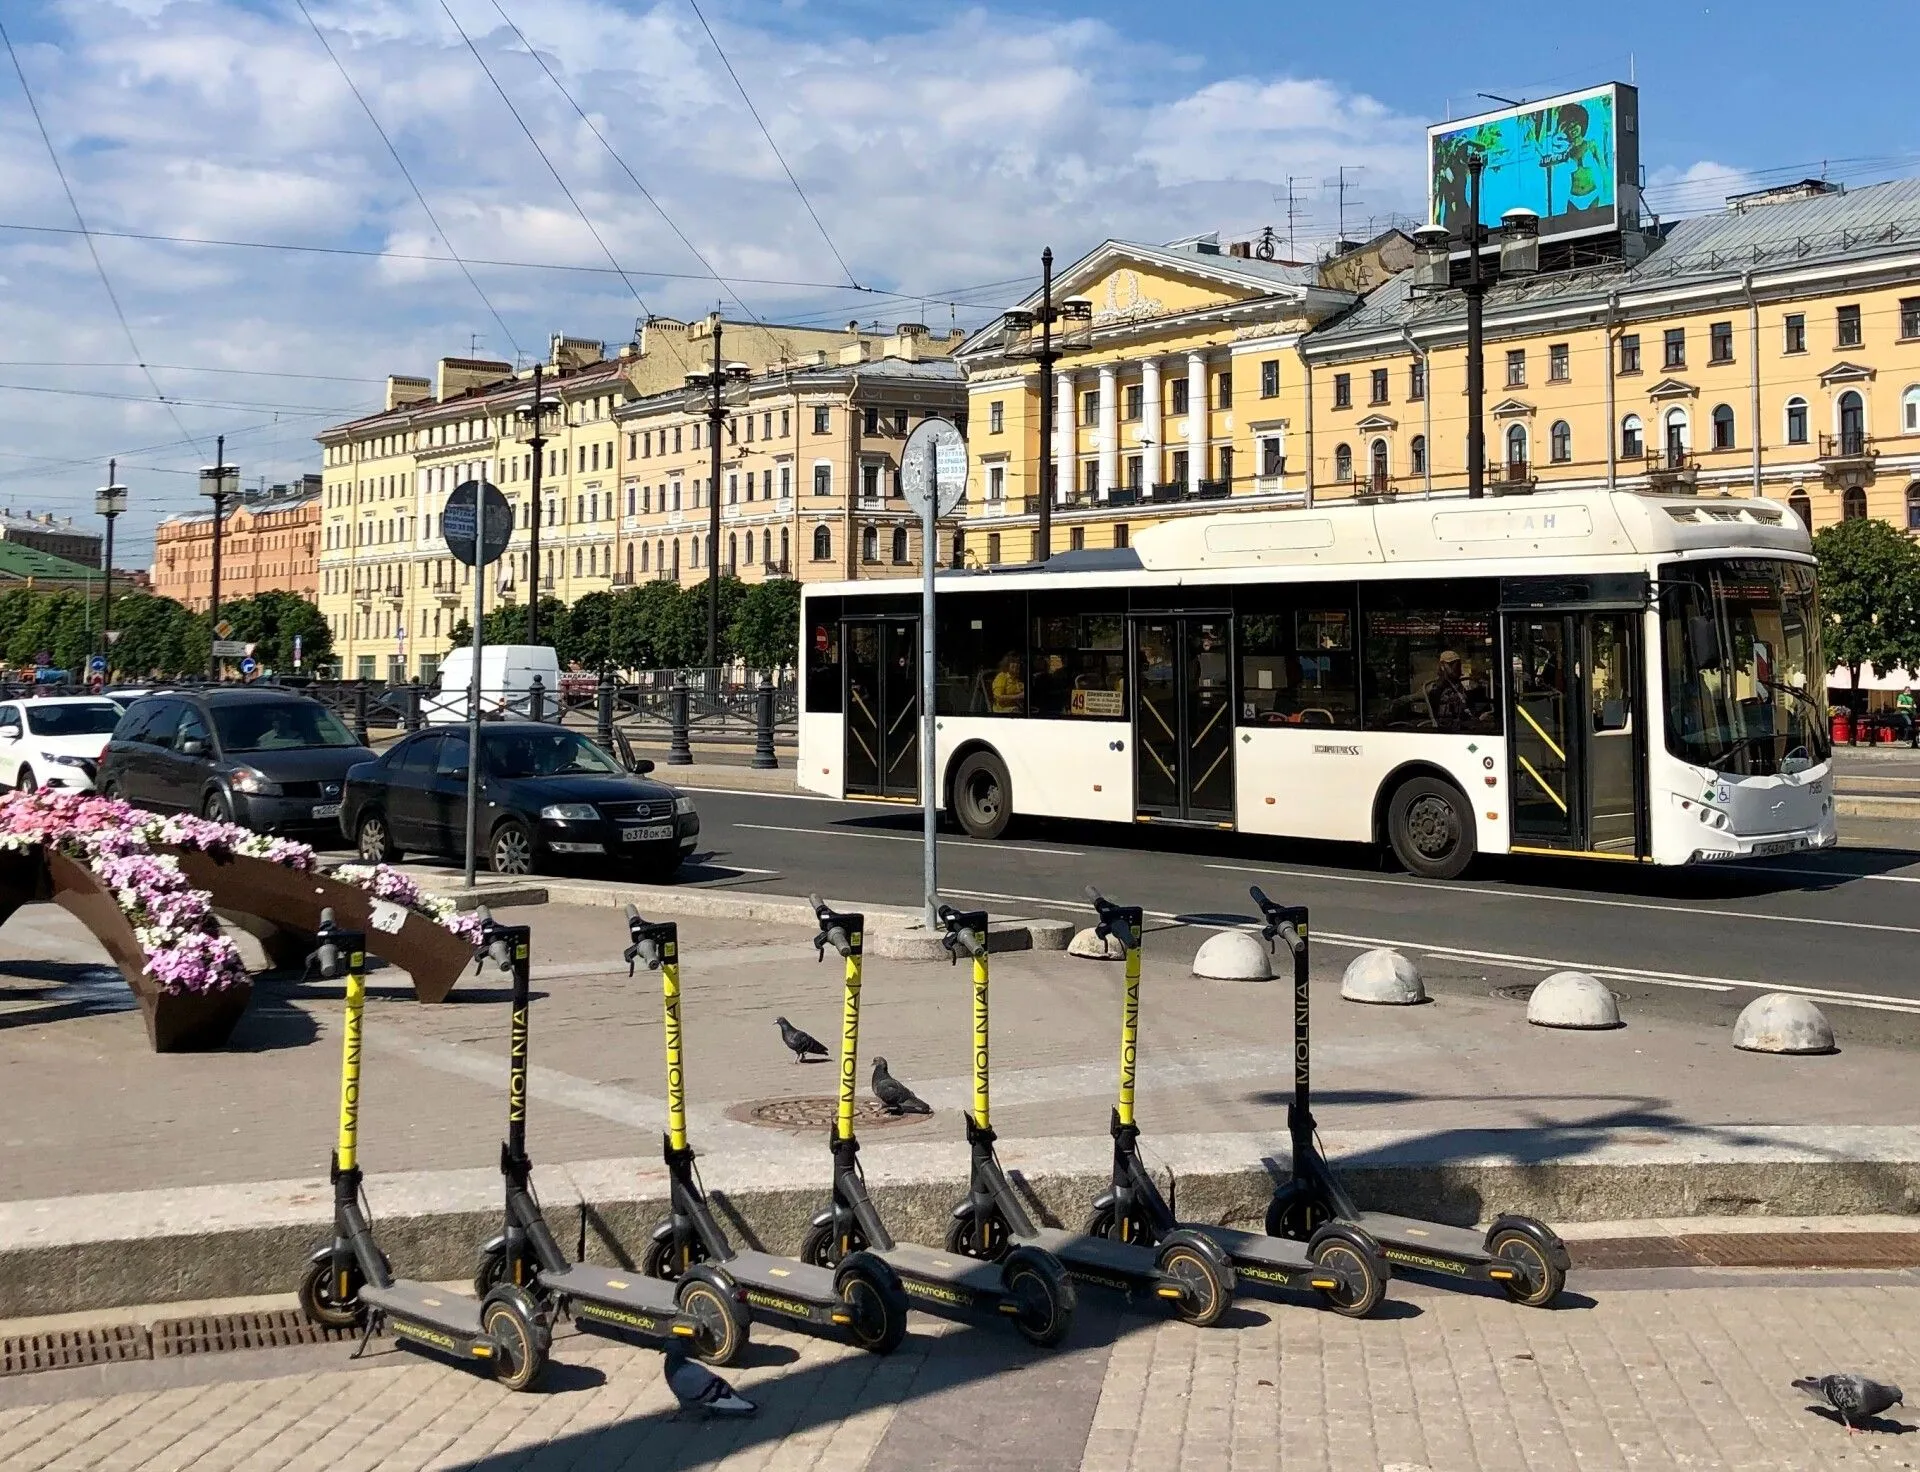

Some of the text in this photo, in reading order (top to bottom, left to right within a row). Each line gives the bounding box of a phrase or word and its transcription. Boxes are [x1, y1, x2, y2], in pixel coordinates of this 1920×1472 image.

[1072, 693, 1085, 710] 49
[344, 1010, 364, 1133] MOLNIA
[511, 1005, 529, 1124] MOLNIA
[665, 995, 684, 1115] MOLNIA
[841, 984, 861, 1104] MOLNIA
[1123, 981, 1140, 1091] MOLNIA
[1295, 981, 1310, 1086] MOLNIA
